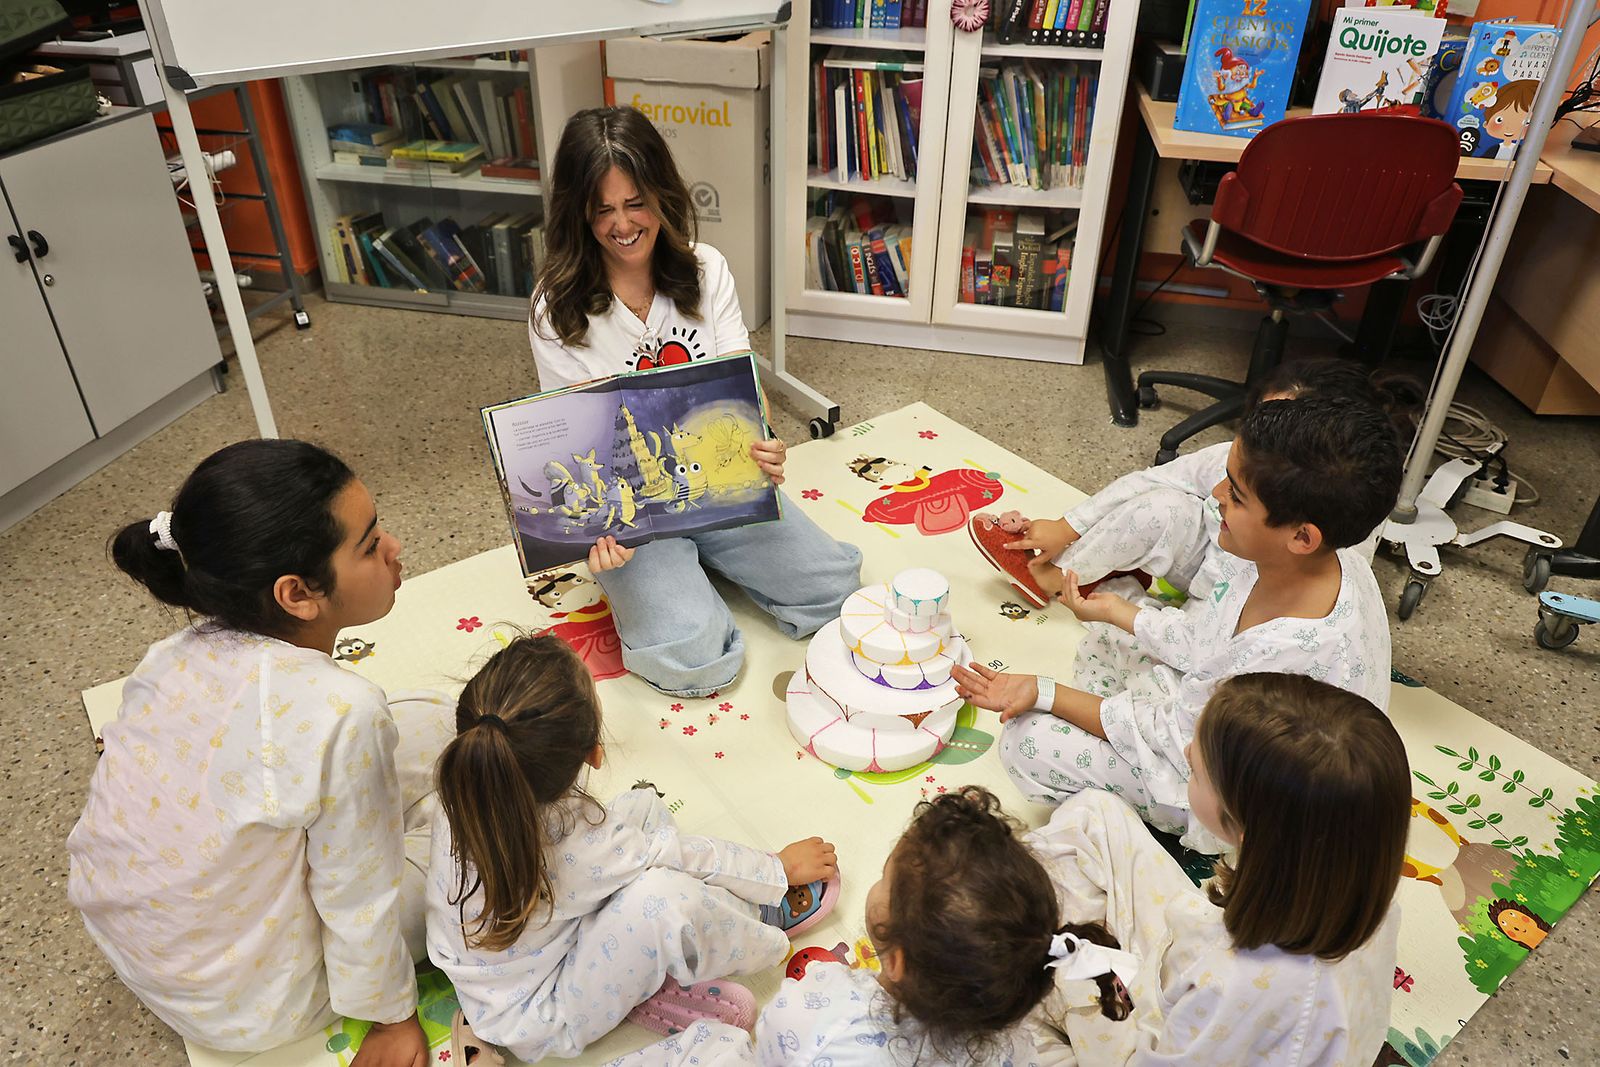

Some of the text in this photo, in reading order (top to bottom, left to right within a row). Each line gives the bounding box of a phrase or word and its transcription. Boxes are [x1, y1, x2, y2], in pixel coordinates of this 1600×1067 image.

[1213, 15, 1295, 35] CUENTOS
[1343, 16, 1379, 27] Mi primer
[1339, 26, 1427, 58] Quijote
[631, 94, 732, 128] ferrovial
[988, 659, 1003, 670] 90
